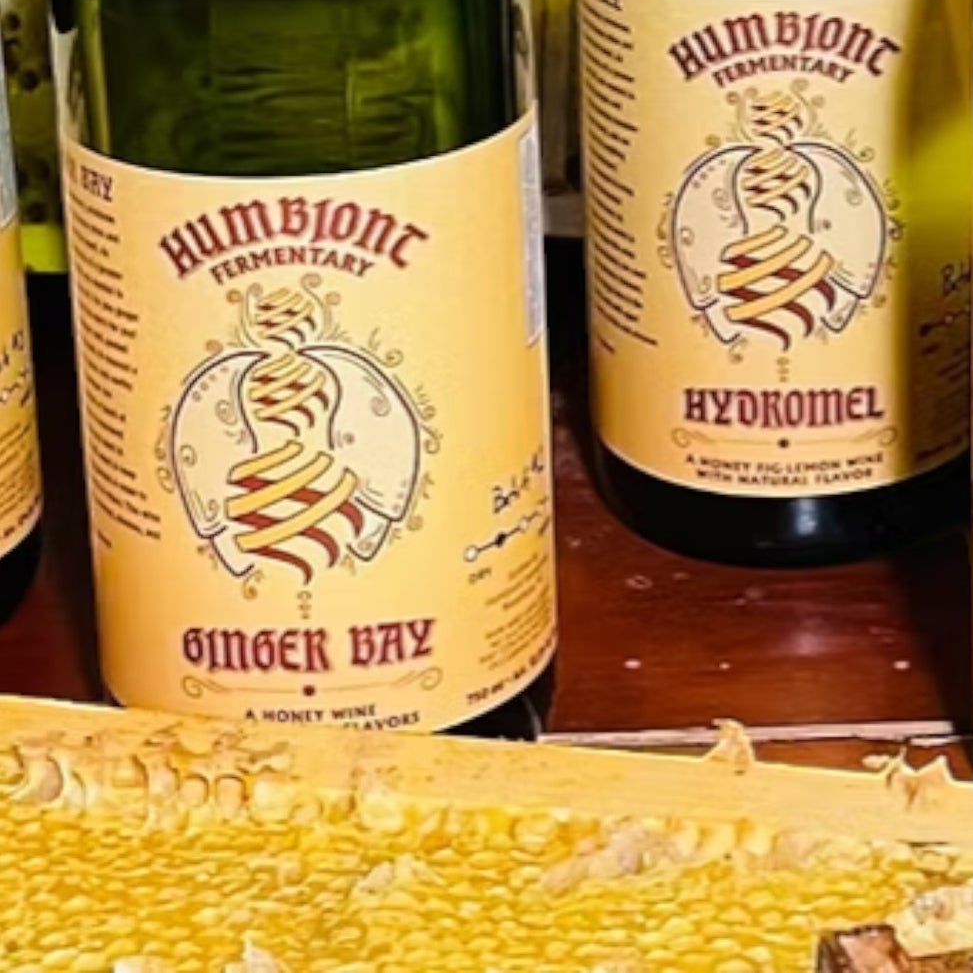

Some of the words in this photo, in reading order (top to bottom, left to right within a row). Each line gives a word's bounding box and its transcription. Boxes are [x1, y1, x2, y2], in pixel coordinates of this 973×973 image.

[712, 54, 854, 87] FERMENTARY
[208, 245, 376, 286] FERMENTARY
[683, 385, 887, 429] HYDROMEL
[700, 458, 751, 472] HONEY
[738, 474, 808, 486] NATURAL
[182, 626, 333, 673] GINGER
[348, 619, 436, 667] BAY
[245, 709, 256, 720] A
[262, 709, 324, 723] HONEY
[331, 704, 375, 720] WINE
